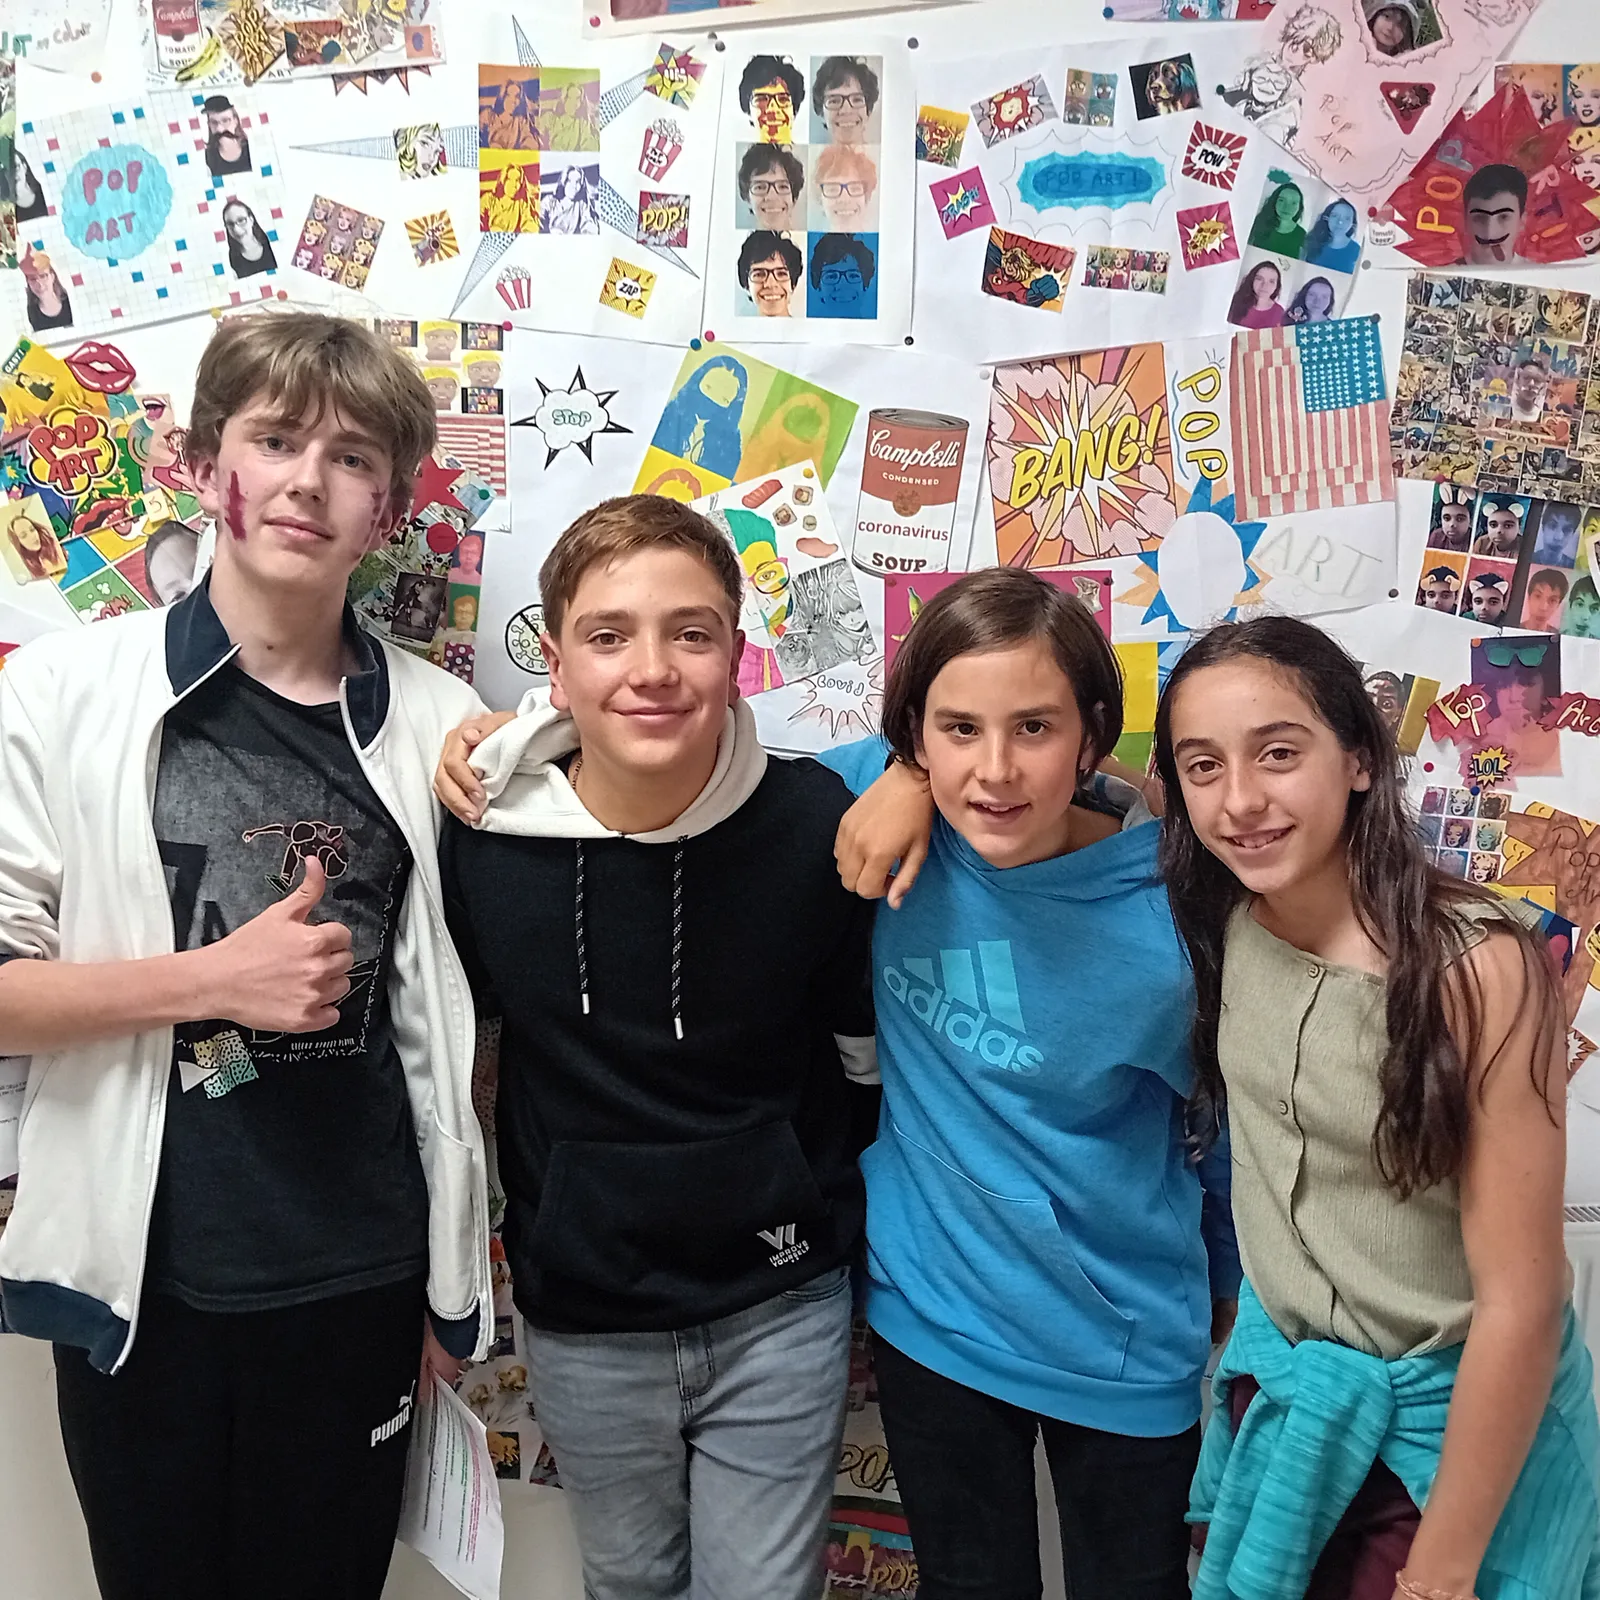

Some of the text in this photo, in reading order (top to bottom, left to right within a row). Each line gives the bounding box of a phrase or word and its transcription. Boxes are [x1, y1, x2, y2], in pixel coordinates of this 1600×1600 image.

[164, 45, 196, 55] TOMATO
[1197, 148, 1226, 168] POW
[82, 160, 143, 206] POP
[1046, 171, 1081, 186] POP
[1092, 172, 1125, 186] ART
[1416, 139, 1475, 234] POP
[85, 211, 136, 245] ART
[642, 206, 687, 233] POP!
[619, 282, 639, 297] ZAP
[28, 414, 99, 465] POP
[1177, 366, 1229, 481] POP
[48, 447, 102, 492] ART
[1009, 403, 1163, 509] BANG!
[882, 471, 940, 486] CONDENSED
[857, 520, 949, 542] coronavirus
[871, 552, 928, 572] SOUP
[1256, 526, 1384, 598] ART
[1434, 685, 1488, 737] Pop
[1473, 757, 1503, 778] LOL
[1549, 825, 1600, 881] Pop
[882, 965, 1045, 1077] adidas
[769, 1239, 807, 1264] IMPROVE
[773, 1245, 810, 1268] YOURSELF
[370, 1404, 410, 1448] PUMA
